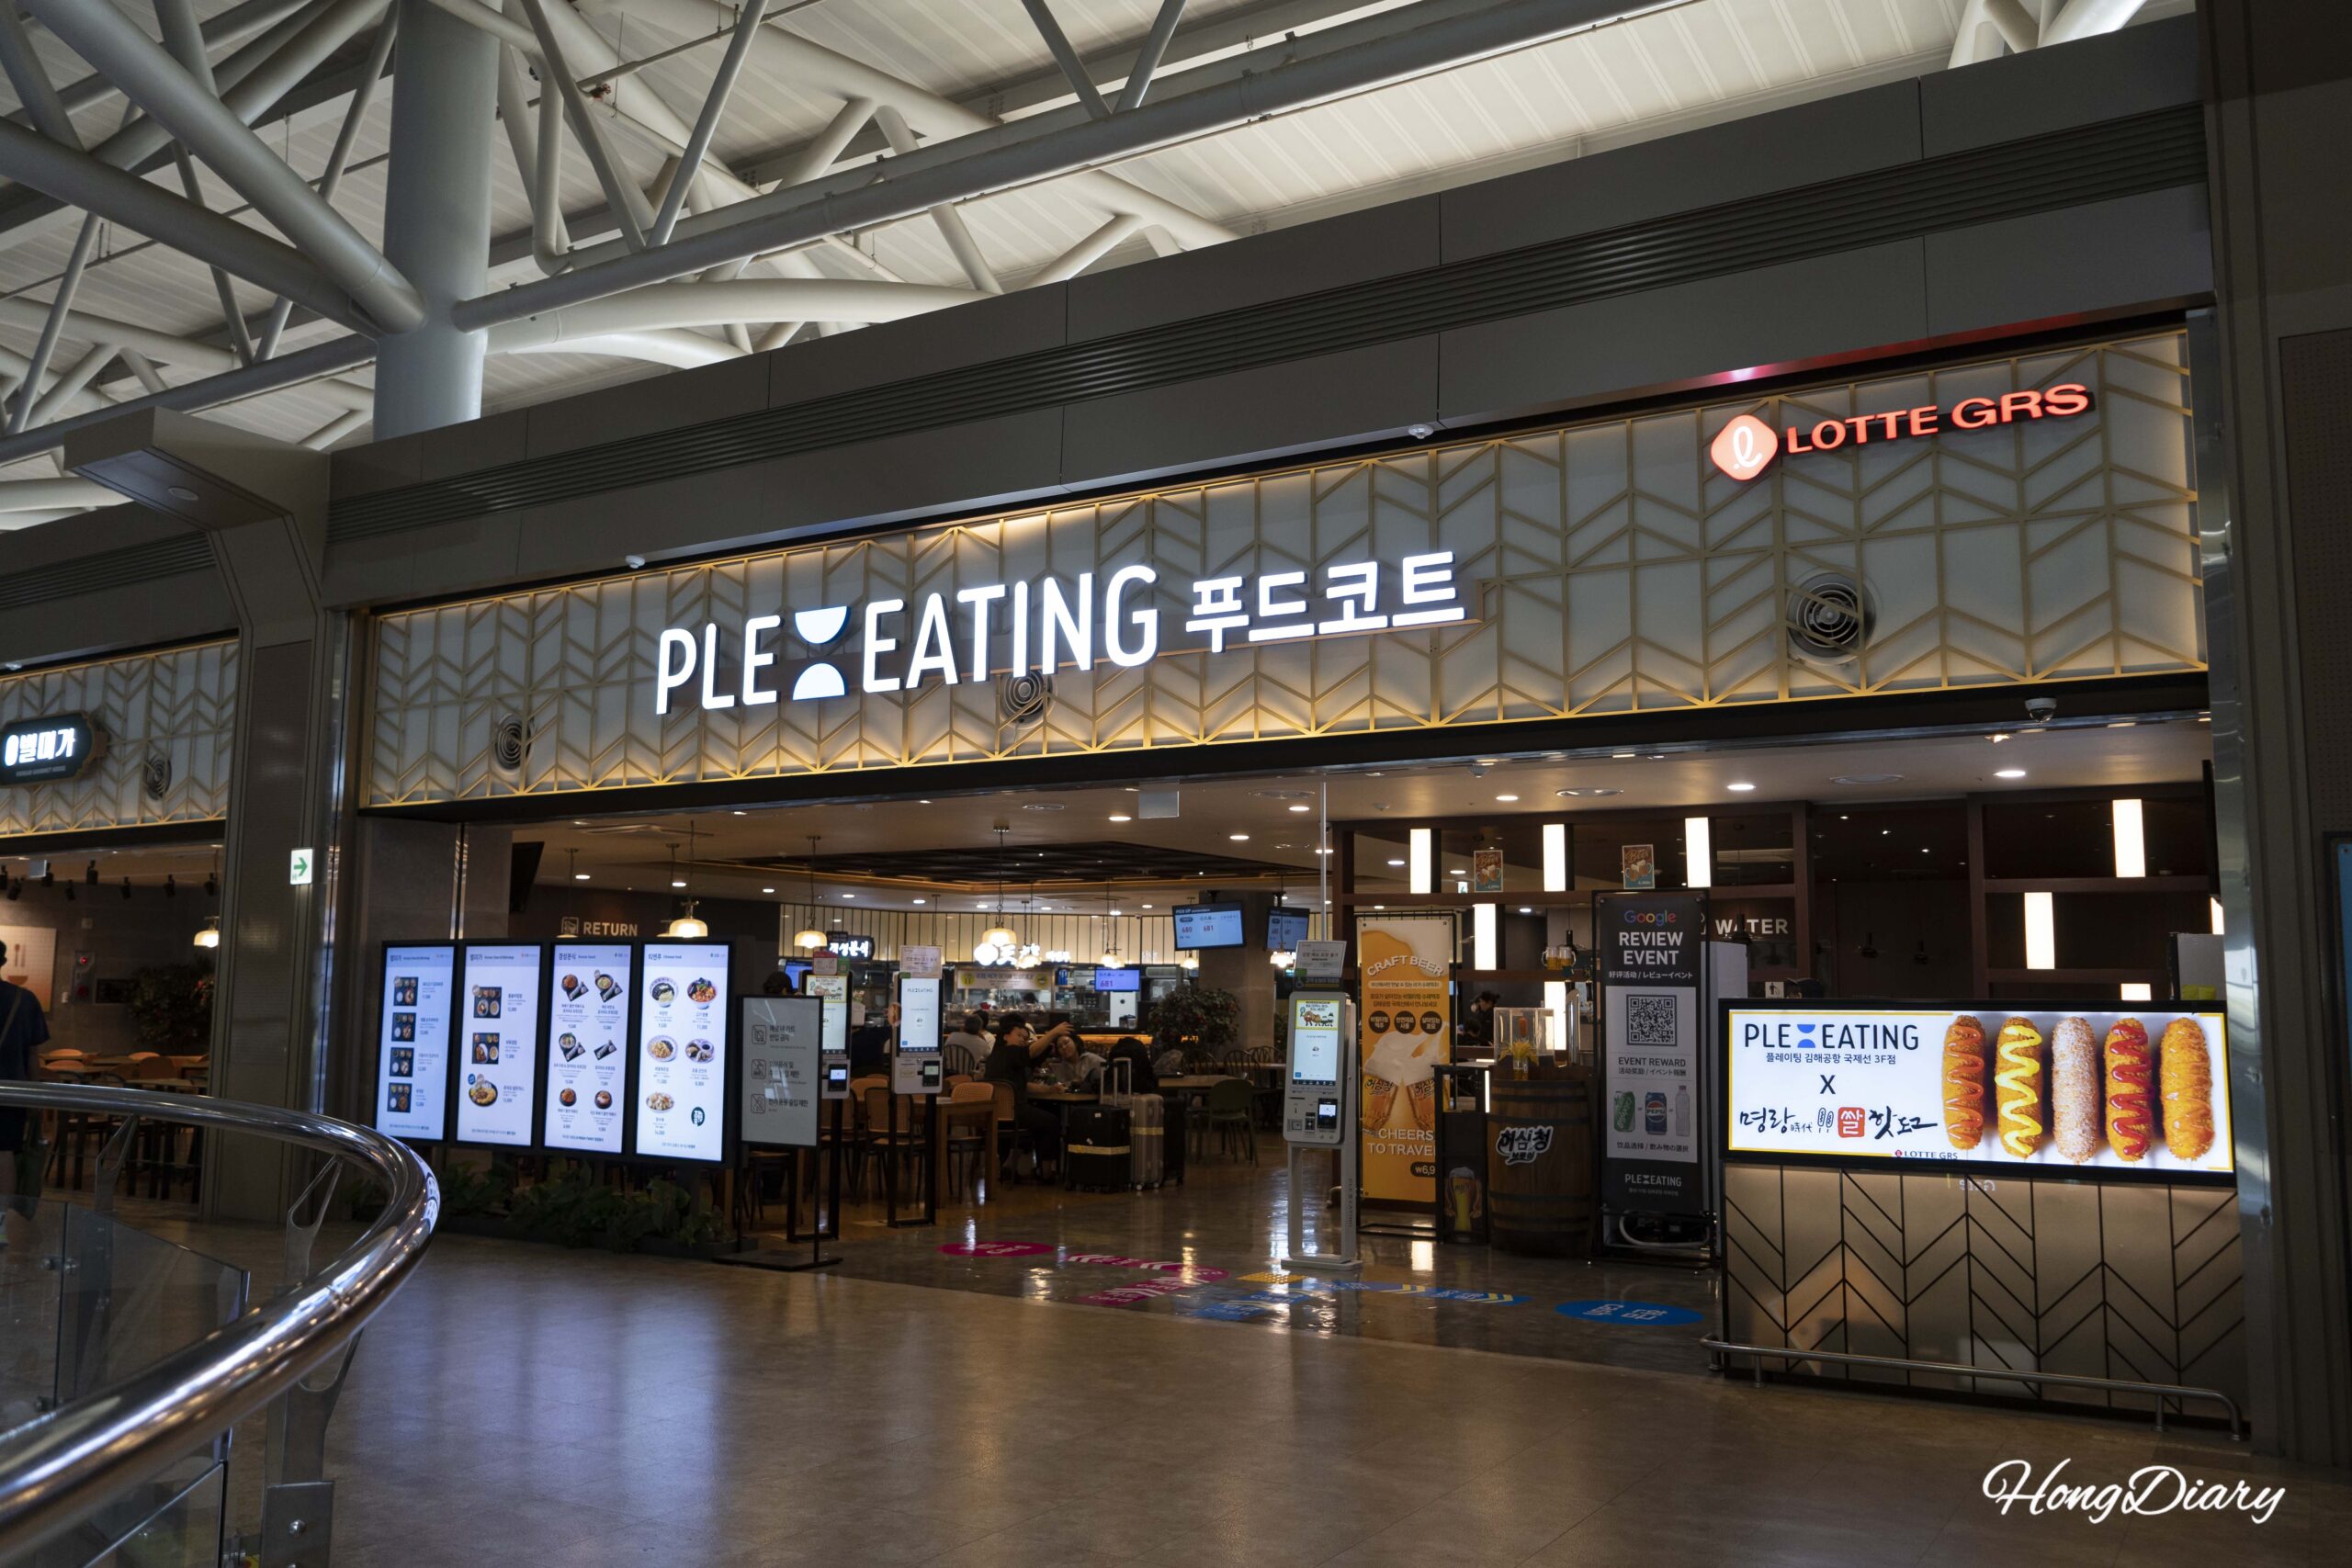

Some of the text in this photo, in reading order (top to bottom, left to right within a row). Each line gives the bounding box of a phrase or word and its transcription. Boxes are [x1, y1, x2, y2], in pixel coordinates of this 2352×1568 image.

[1787, 383, 2089, 454] LOTTE GRS
[1185, 551, 1466, 653] 푸드코트
[18, 727, 76, 764] 별미가
[1623, 909, 1677, 927] Google
[583, 921, 638, 937] RETURN
[1715, 919, 1789, 935] WTER
[1619, 931, 1684, 946] REVIEW
[1367, 955, 1444, 977] CRAFT BEER
[1623, 950, 1679, 965] EVENT
[1609, 970, 1637, 978] 好评活动
[1643, 971, 1693, 979] レビューイベント
[1618, 1056, 1686, 1067] EVENT REWARD
[1766, 1052, 1896, 1065] 플레이팅 김해공항 국제선 3F점
[1820, 1074, 1837, 1095] X
[1739, 1107, 1814, 1134] 명랑 時代
[1840, 1109, 1864, 1135] 쌀
[1869, 1105, 1939, 1140] 핫도그
[1378, 1129, 1434, 1141] CHEERS
[1496, 1127, 1553, 1154] 허심청
[1367, 1143, 1436, 1156] TO TRAVE
[1905, 1150, 1958, 1160] LOTTE GRS
